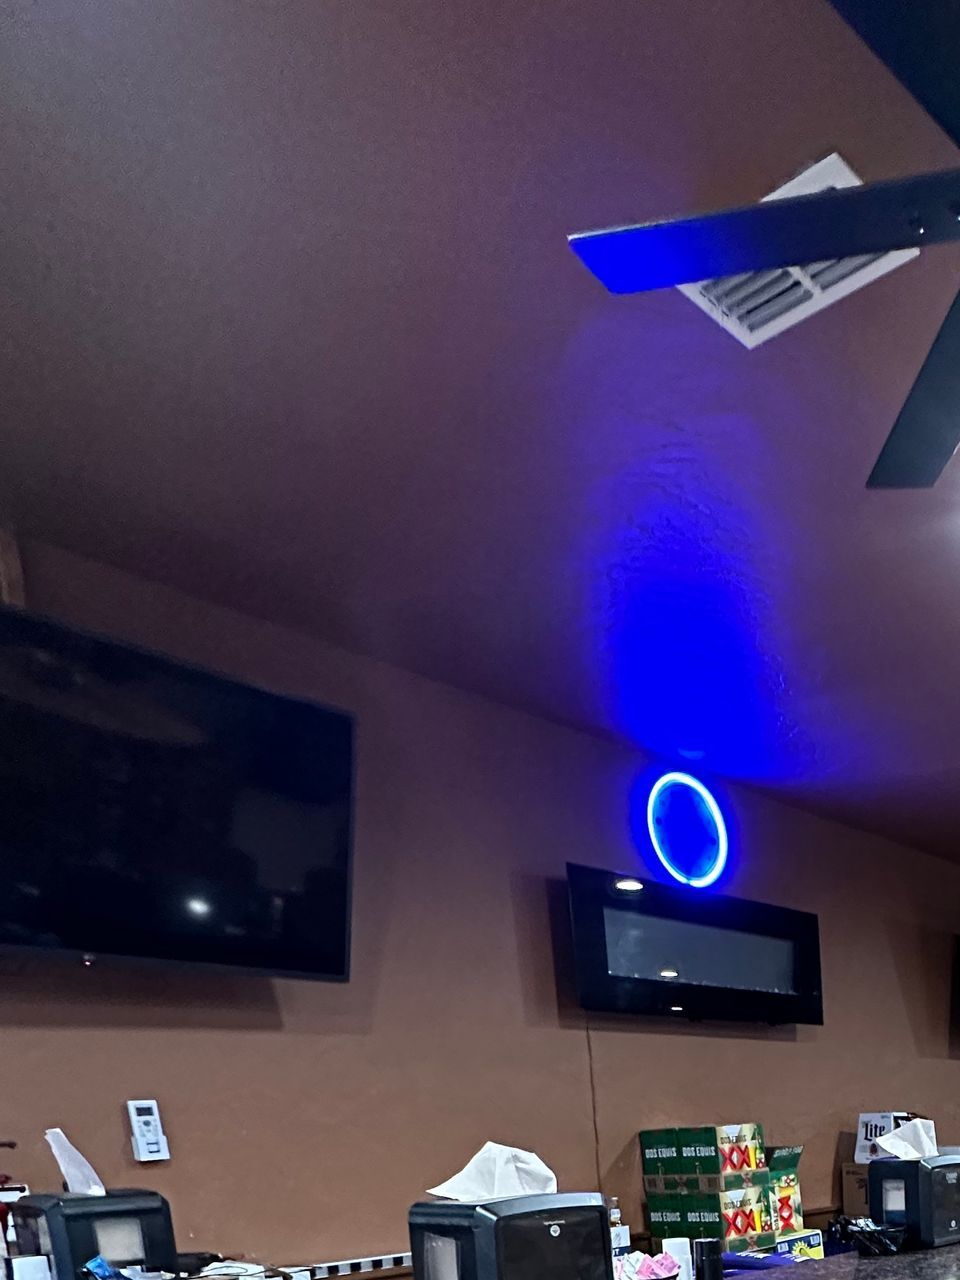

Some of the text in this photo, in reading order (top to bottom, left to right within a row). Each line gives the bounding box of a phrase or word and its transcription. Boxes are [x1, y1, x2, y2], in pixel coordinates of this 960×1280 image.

[864, 1122, 886, 1142] Lite
[645, 1147, 677, 1158] DOS EQUIS
[682, 1146, 716, 1157] DOS EQUIS
[719, 1145, 750, 1171] XX
[650, 1212, 680, 1222] DOS EQUIS
[687, 1212, 720, 1222] DOS EQUIS
[722, 1209, 755, 1237] XX
